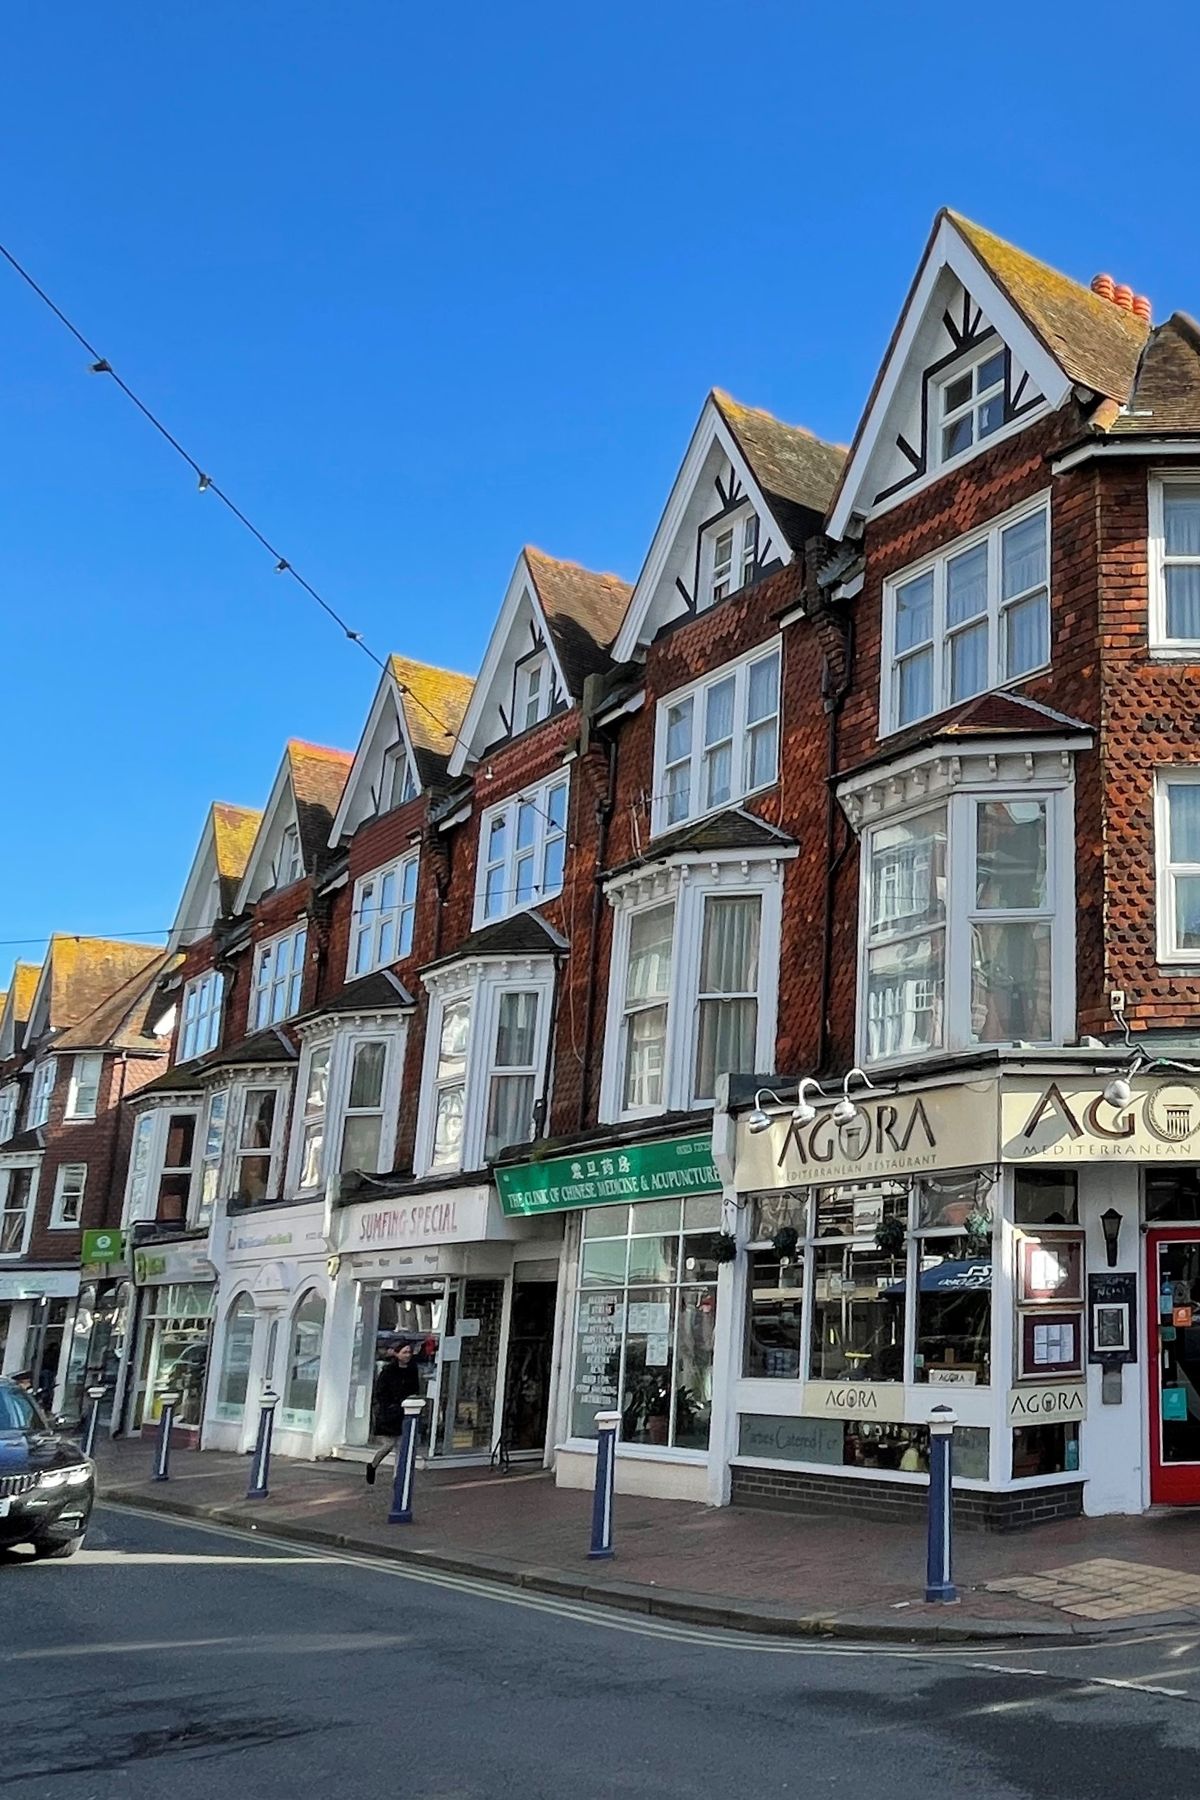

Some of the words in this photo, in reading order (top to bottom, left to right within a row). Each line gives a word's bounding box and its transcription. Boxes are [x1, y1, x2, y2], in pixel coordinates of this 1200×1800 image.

[777, 1097, 937, 1168] AGORA
[1023, 1143, 1191, 1156] MEDITERRANEAN
[867, 1154, 937, 1171] RESTAURANT
[507, 1191, 524, 1208] THE
[524, 1188, 549, 1206] CLINIC
[550, 1187, 560, 1203] OF
[561, 1182, 595, 1200] CHINESE
[598, 1176, 640, 1197] MEDICINE
[641, 1176, 650, 1191] &
[651, 1164, 721, 1190] ACUPUNCTURE
[360, 1209, 408, 1241] SUMFING
[410, 1202, 458, 1234] SPECIAL
[938, 1373, 965, 1383] AGORA
[825, 1388, 877, 1409] AGORA
[1010, 1391, 1083, 1415] AGORA
